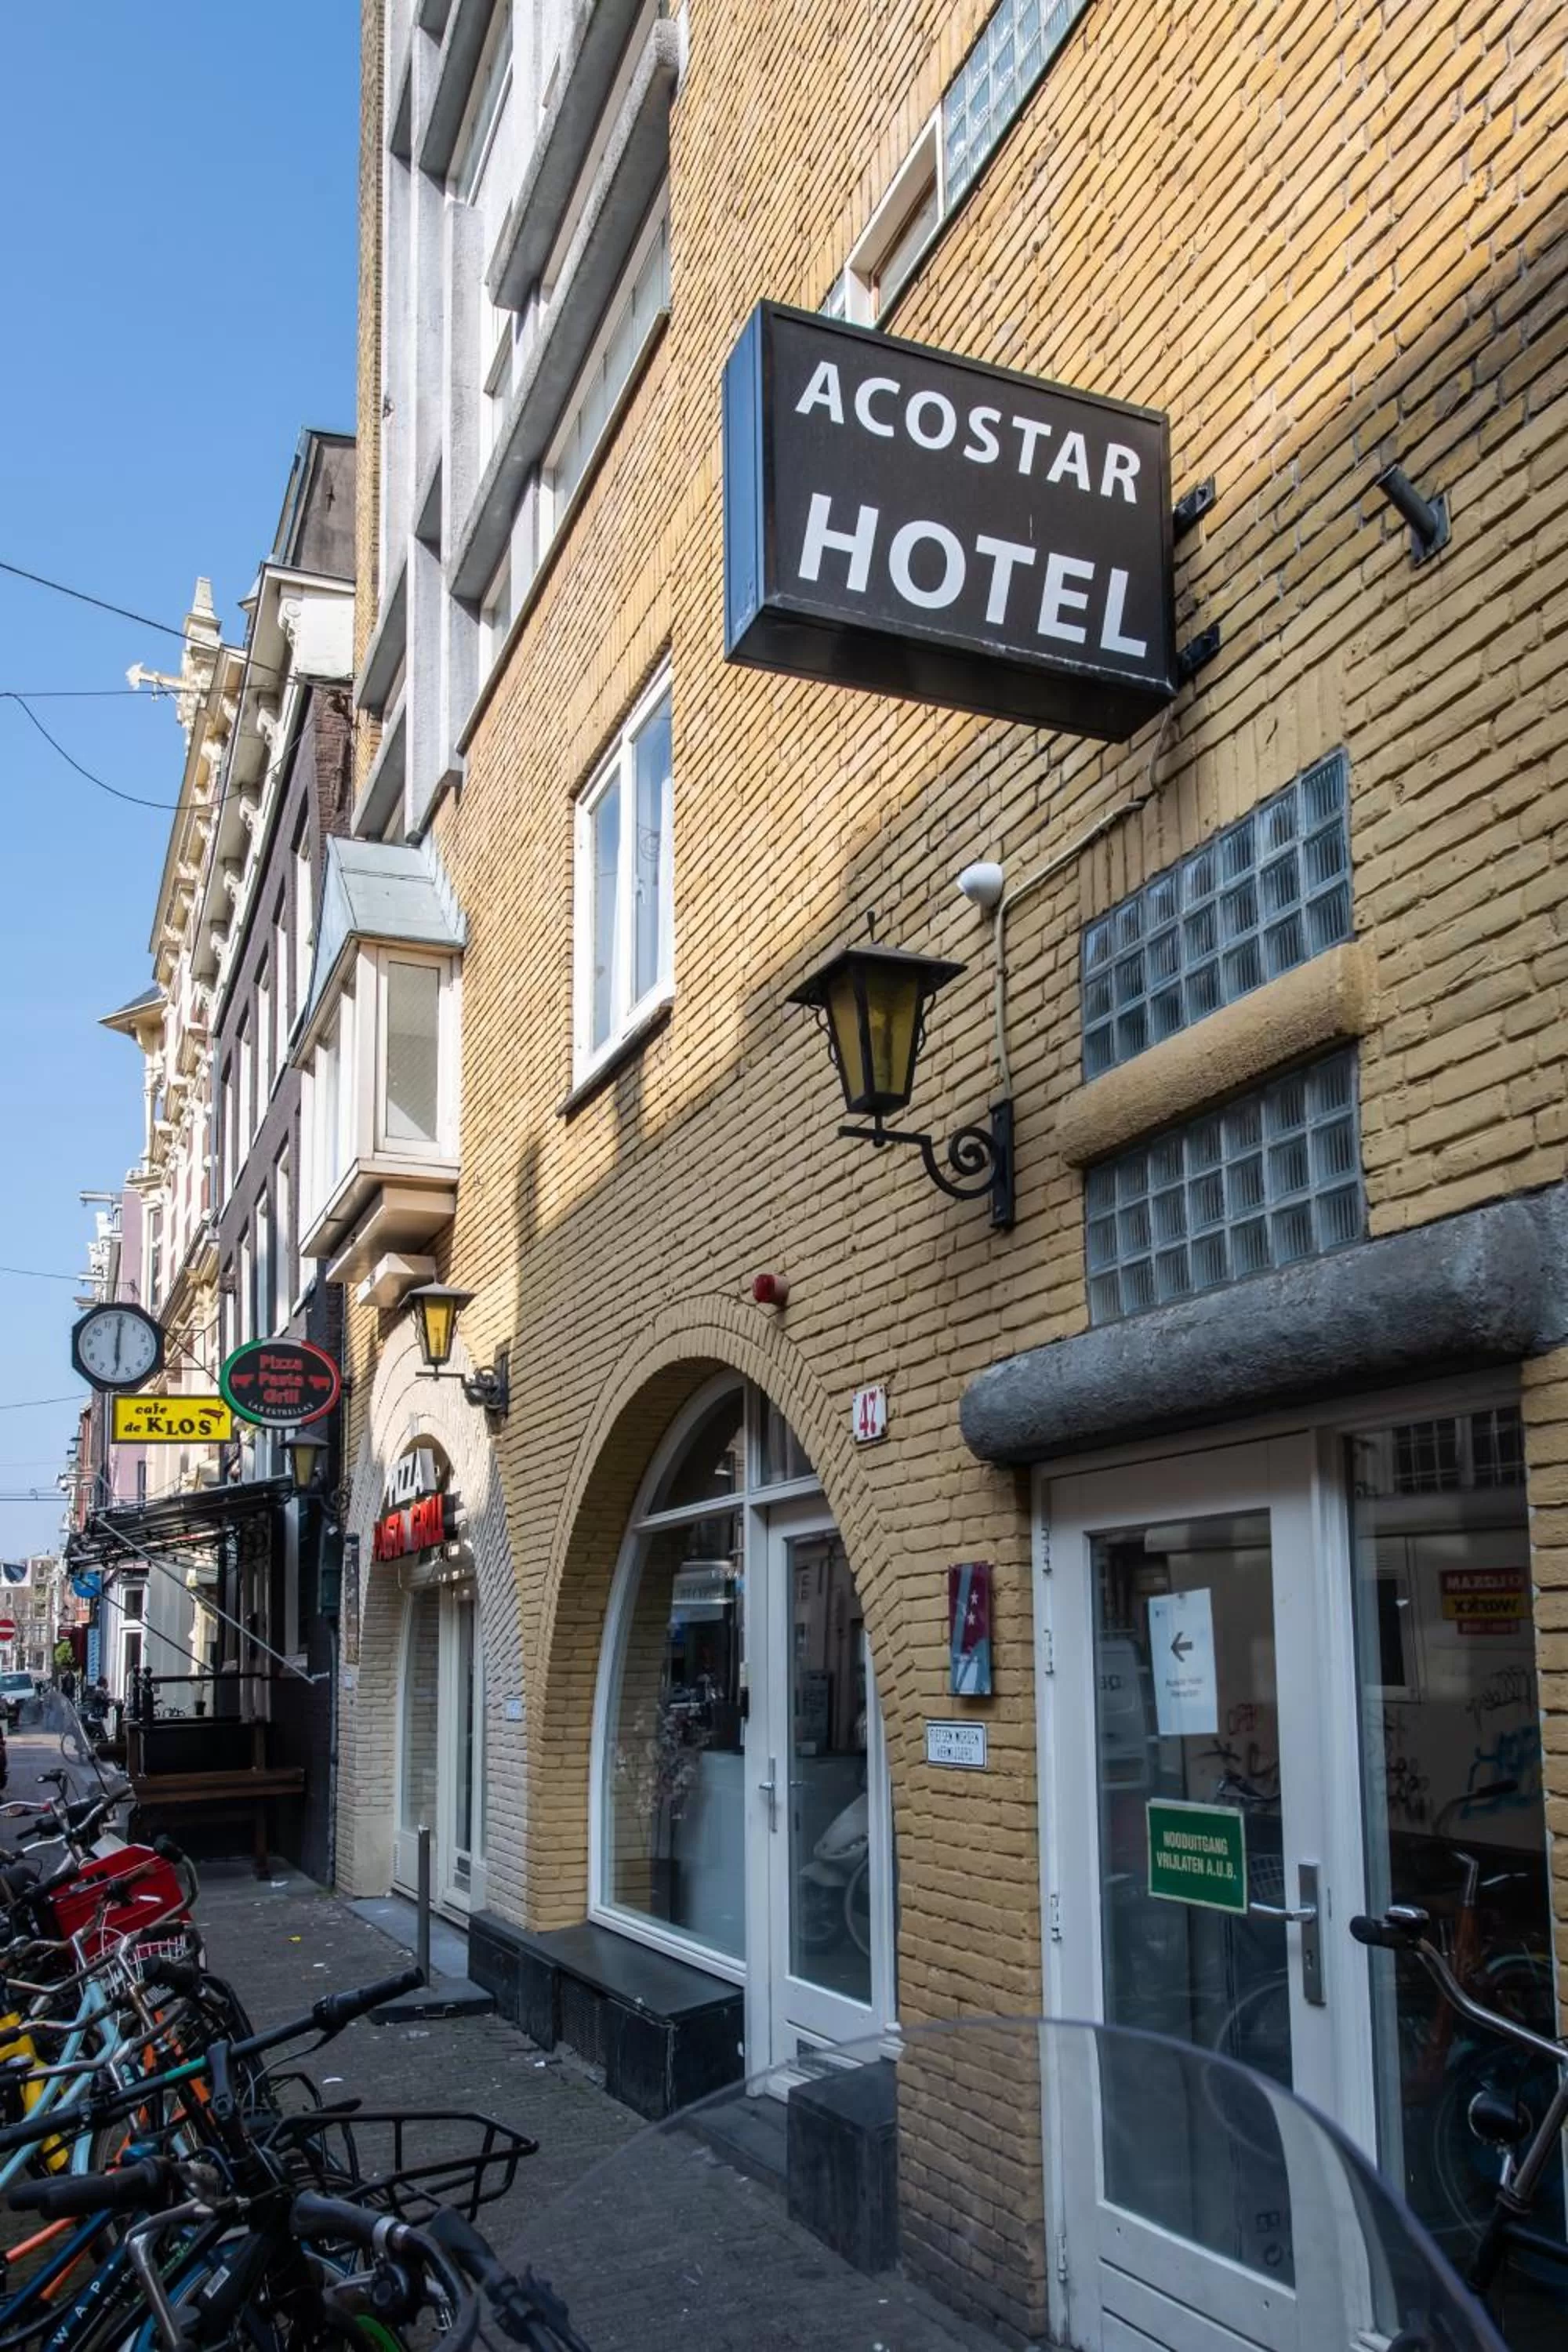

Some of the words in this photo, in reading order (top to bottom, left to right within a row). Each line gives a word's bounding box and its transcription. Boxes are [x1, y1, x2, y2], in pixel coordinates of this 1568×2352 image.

[794, 360, 1142, 504] ACOSTAR
[797, 492, 1148, 659] HOTEL
[260, 1354, 303, 1370] Pizza
[258, 1372, 303, 1387] Pasta
[263, 1388, 299, 1404] Grill
[859, 1388, 877, 1437] 47
[124, 1421, 142, 1432] de
[147, 1417, 212, 1436] KLOS
[1163, 1831, 1229, 1856] NOODUITGANG
[1156, 1850, 1204, 1875] VRIJLATEN
[1207, 1858, 1237, 1880] A.U.B.
